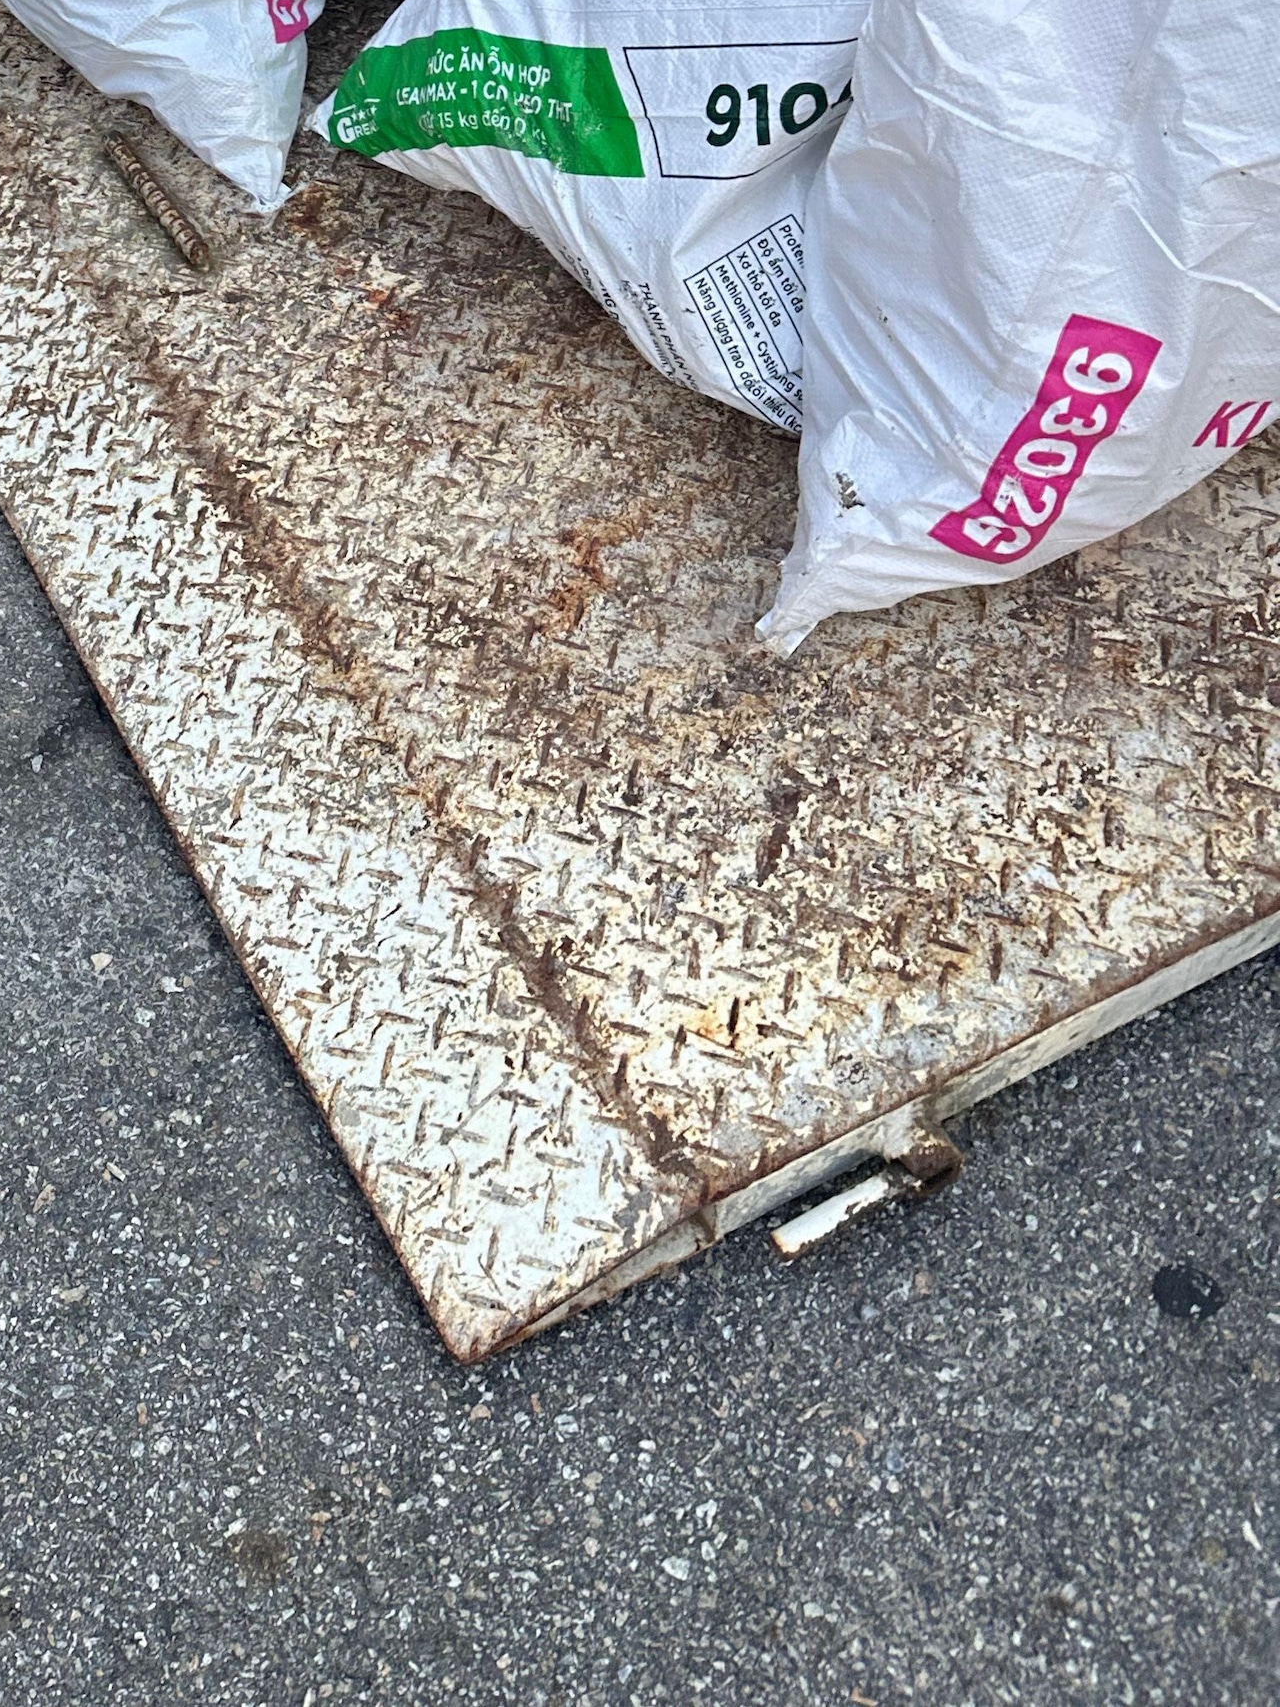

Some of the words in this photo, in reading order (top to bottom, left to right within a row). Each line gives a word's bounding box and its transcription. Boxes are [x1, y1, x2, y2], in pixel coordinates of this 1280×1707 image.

[426, 48, 455, 77] HỨC
[459, 46, 485, 73] ĂN
[487, 45, 514, 82] ỖN
[519, 64, 551, 93] HỢP
[423, 81, 457, 104] MAX
[470, 80, 478, 99] 1
[438, 112, 454, 129] 15
[458, 110, 479, 130] kg
[482, 107, 511, 131] đến
[757, 238, 773, 258] Độ
[715, 264, 755, 330] Methionine
[736, 250, 751, 268] Xơ
[768, 310, 782, 329] đa
[780, 278, 800, 300] tối
[789, 297, 804, 314] đa
[694, 277, 717, 312] Năng
[710, 308, 734, 345] lượng
[727, 342, 746, 370] trao
[961, 345, 1135, 555] 9302G
